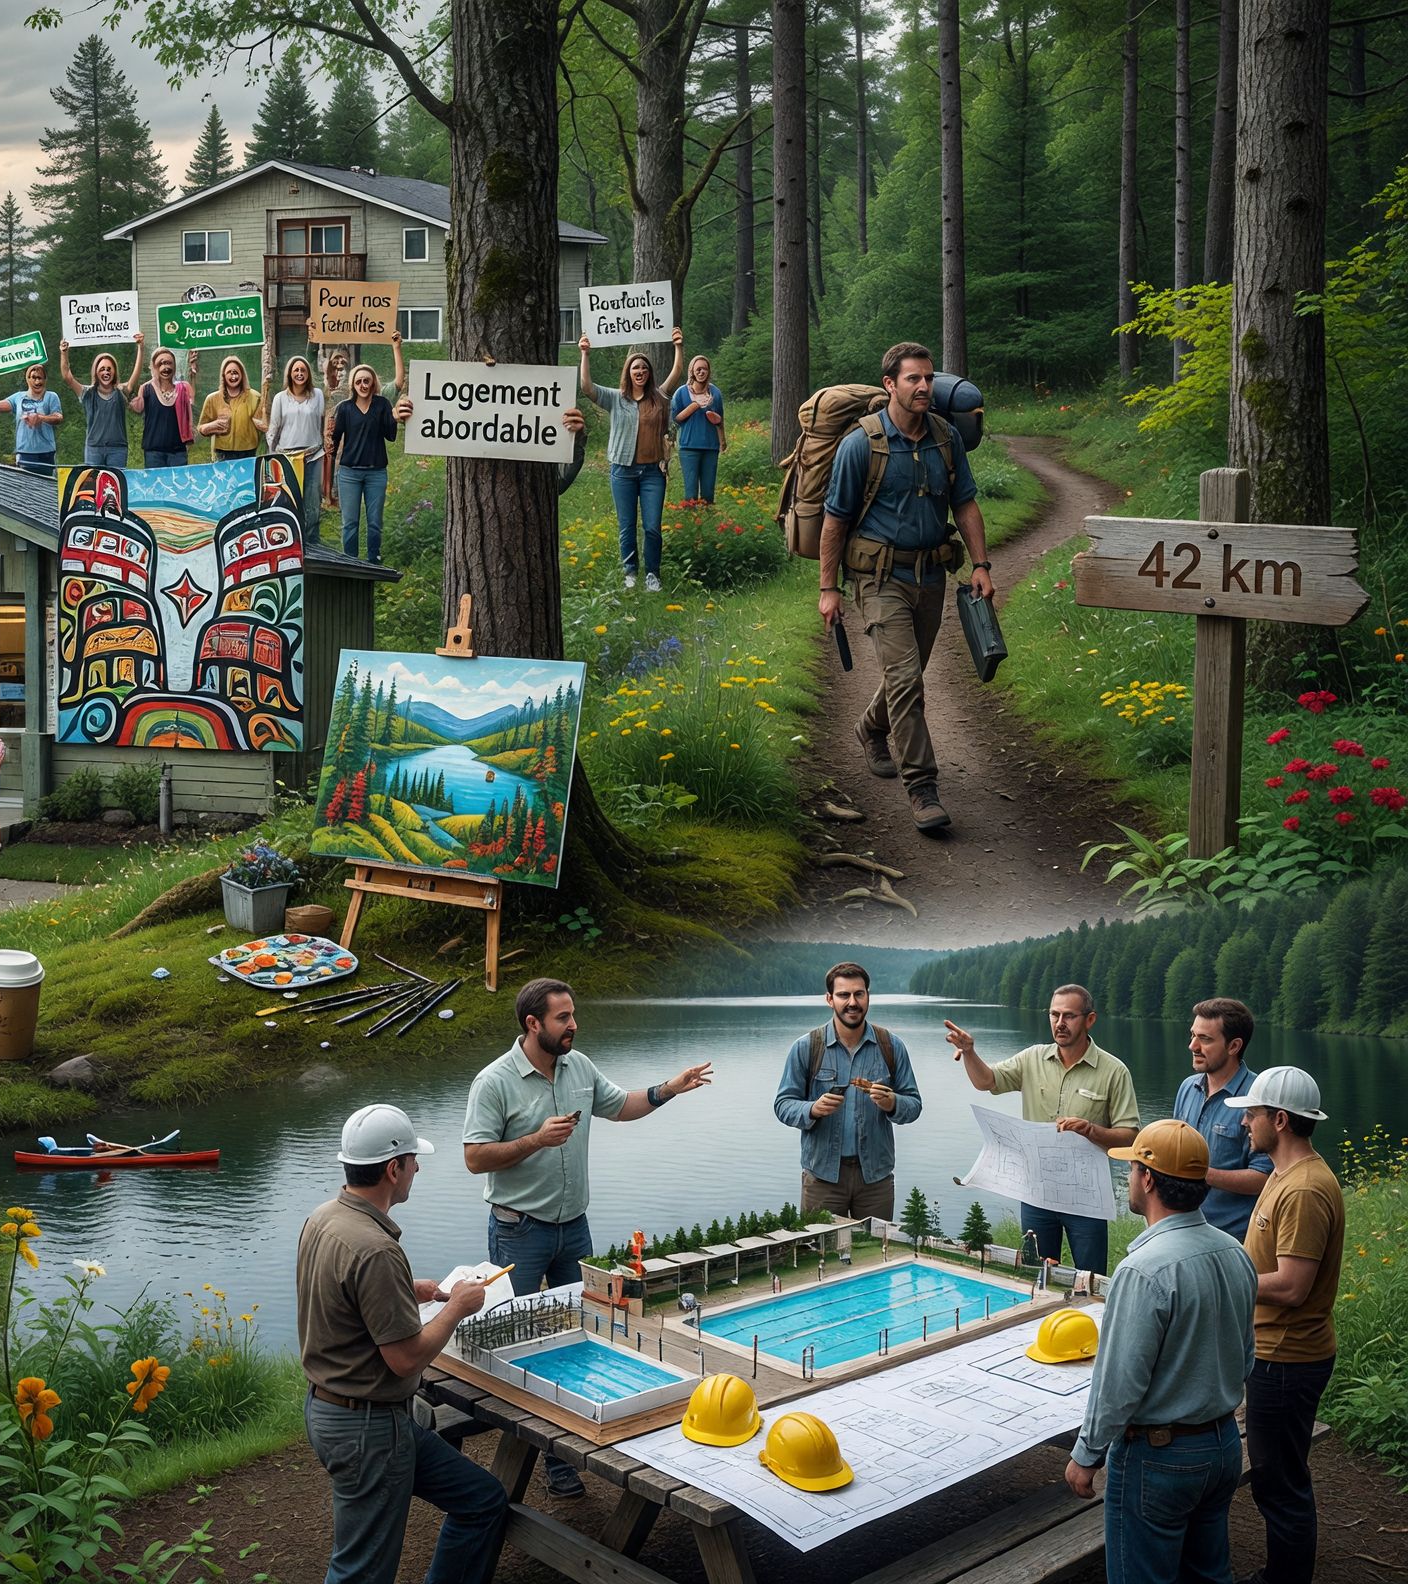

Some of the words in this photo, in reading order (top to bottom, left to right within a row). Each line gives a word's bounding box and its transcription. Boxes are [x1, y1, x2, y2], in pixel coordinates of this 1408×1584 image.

[319, 288, 355, 307] Pour
[362, 296, 391, 307] nos
[424, 372, 561, 411] Logement
[420, 410, 557, 446] abordable
[1137, 540, 1203, 590] 42
[1221, 543, 1302, 597] km
